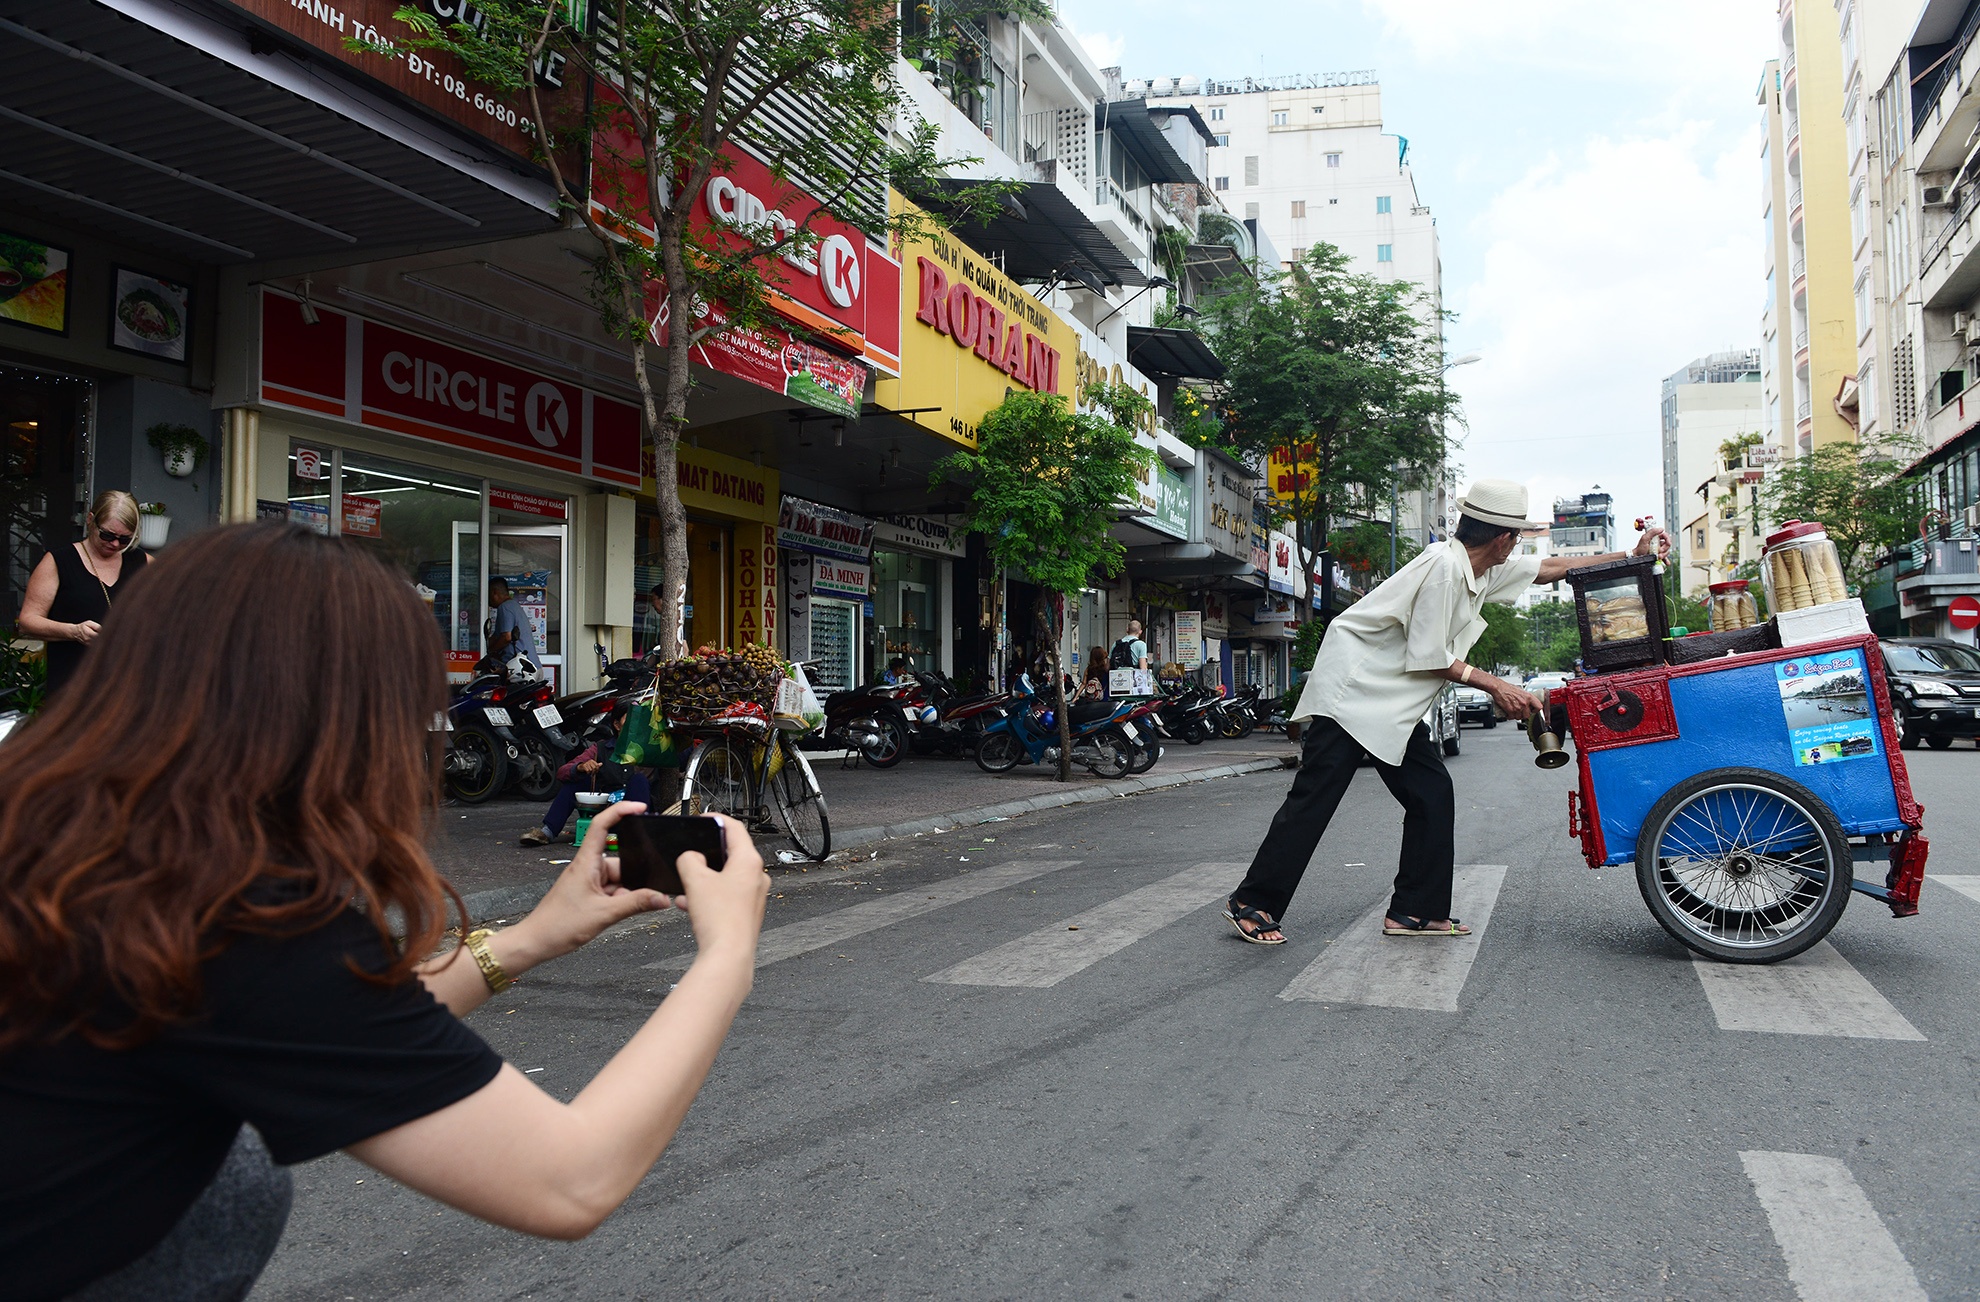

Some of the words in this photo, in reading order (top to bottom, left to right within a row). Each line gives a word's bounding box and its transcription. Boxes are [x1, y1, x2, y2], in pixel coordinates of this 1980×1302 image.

[1323, 69, 1379, 88] HOTEL
[443, 74, 470, 103] 08.
[474, 93, 516, 127] 6680
[828, 240, 860, 305] K
[997, 279, 1008, 306] ÁO
[1009, 293, 1025, 319] THỜI
[1027, 304, 1048, 335] TRANG
[915, 255, 1061, 395] ROHANI
[731, 334, 748, 349] NAM
[382, 351, 516, 423] CIRCLE
[530, 388, 568, 444] K
[950, 416, 963, 436] 146
[965, 423, 974, 441] Lê
[641, 451, 708, 491] SEMAT
[712, 470, 765, 506] DATANG
[513, 502, 541, 513] Welcome
[782, 531, 807, 544] CHUYÊN
[808, 537, 829, 549] NGHIỆP
[794, 513, 817, 536] ĐA
[820, 520, 862, 546] MINH
[895, 533, 940, 550] JEWELLERY
[763, 525, 776, 648] ROHANI
[820, 565, 834, 581] ĐA
[836, 568, 864, 586] MINH
[1794, 729, 1811, 738] Enjoy
[1813, 726, 1832, 734] rowing
[1803, 736, 1812, 744] the
[1813, 735, 1833, 743] Saigon
[1851, 729, 1871, 737] canals
